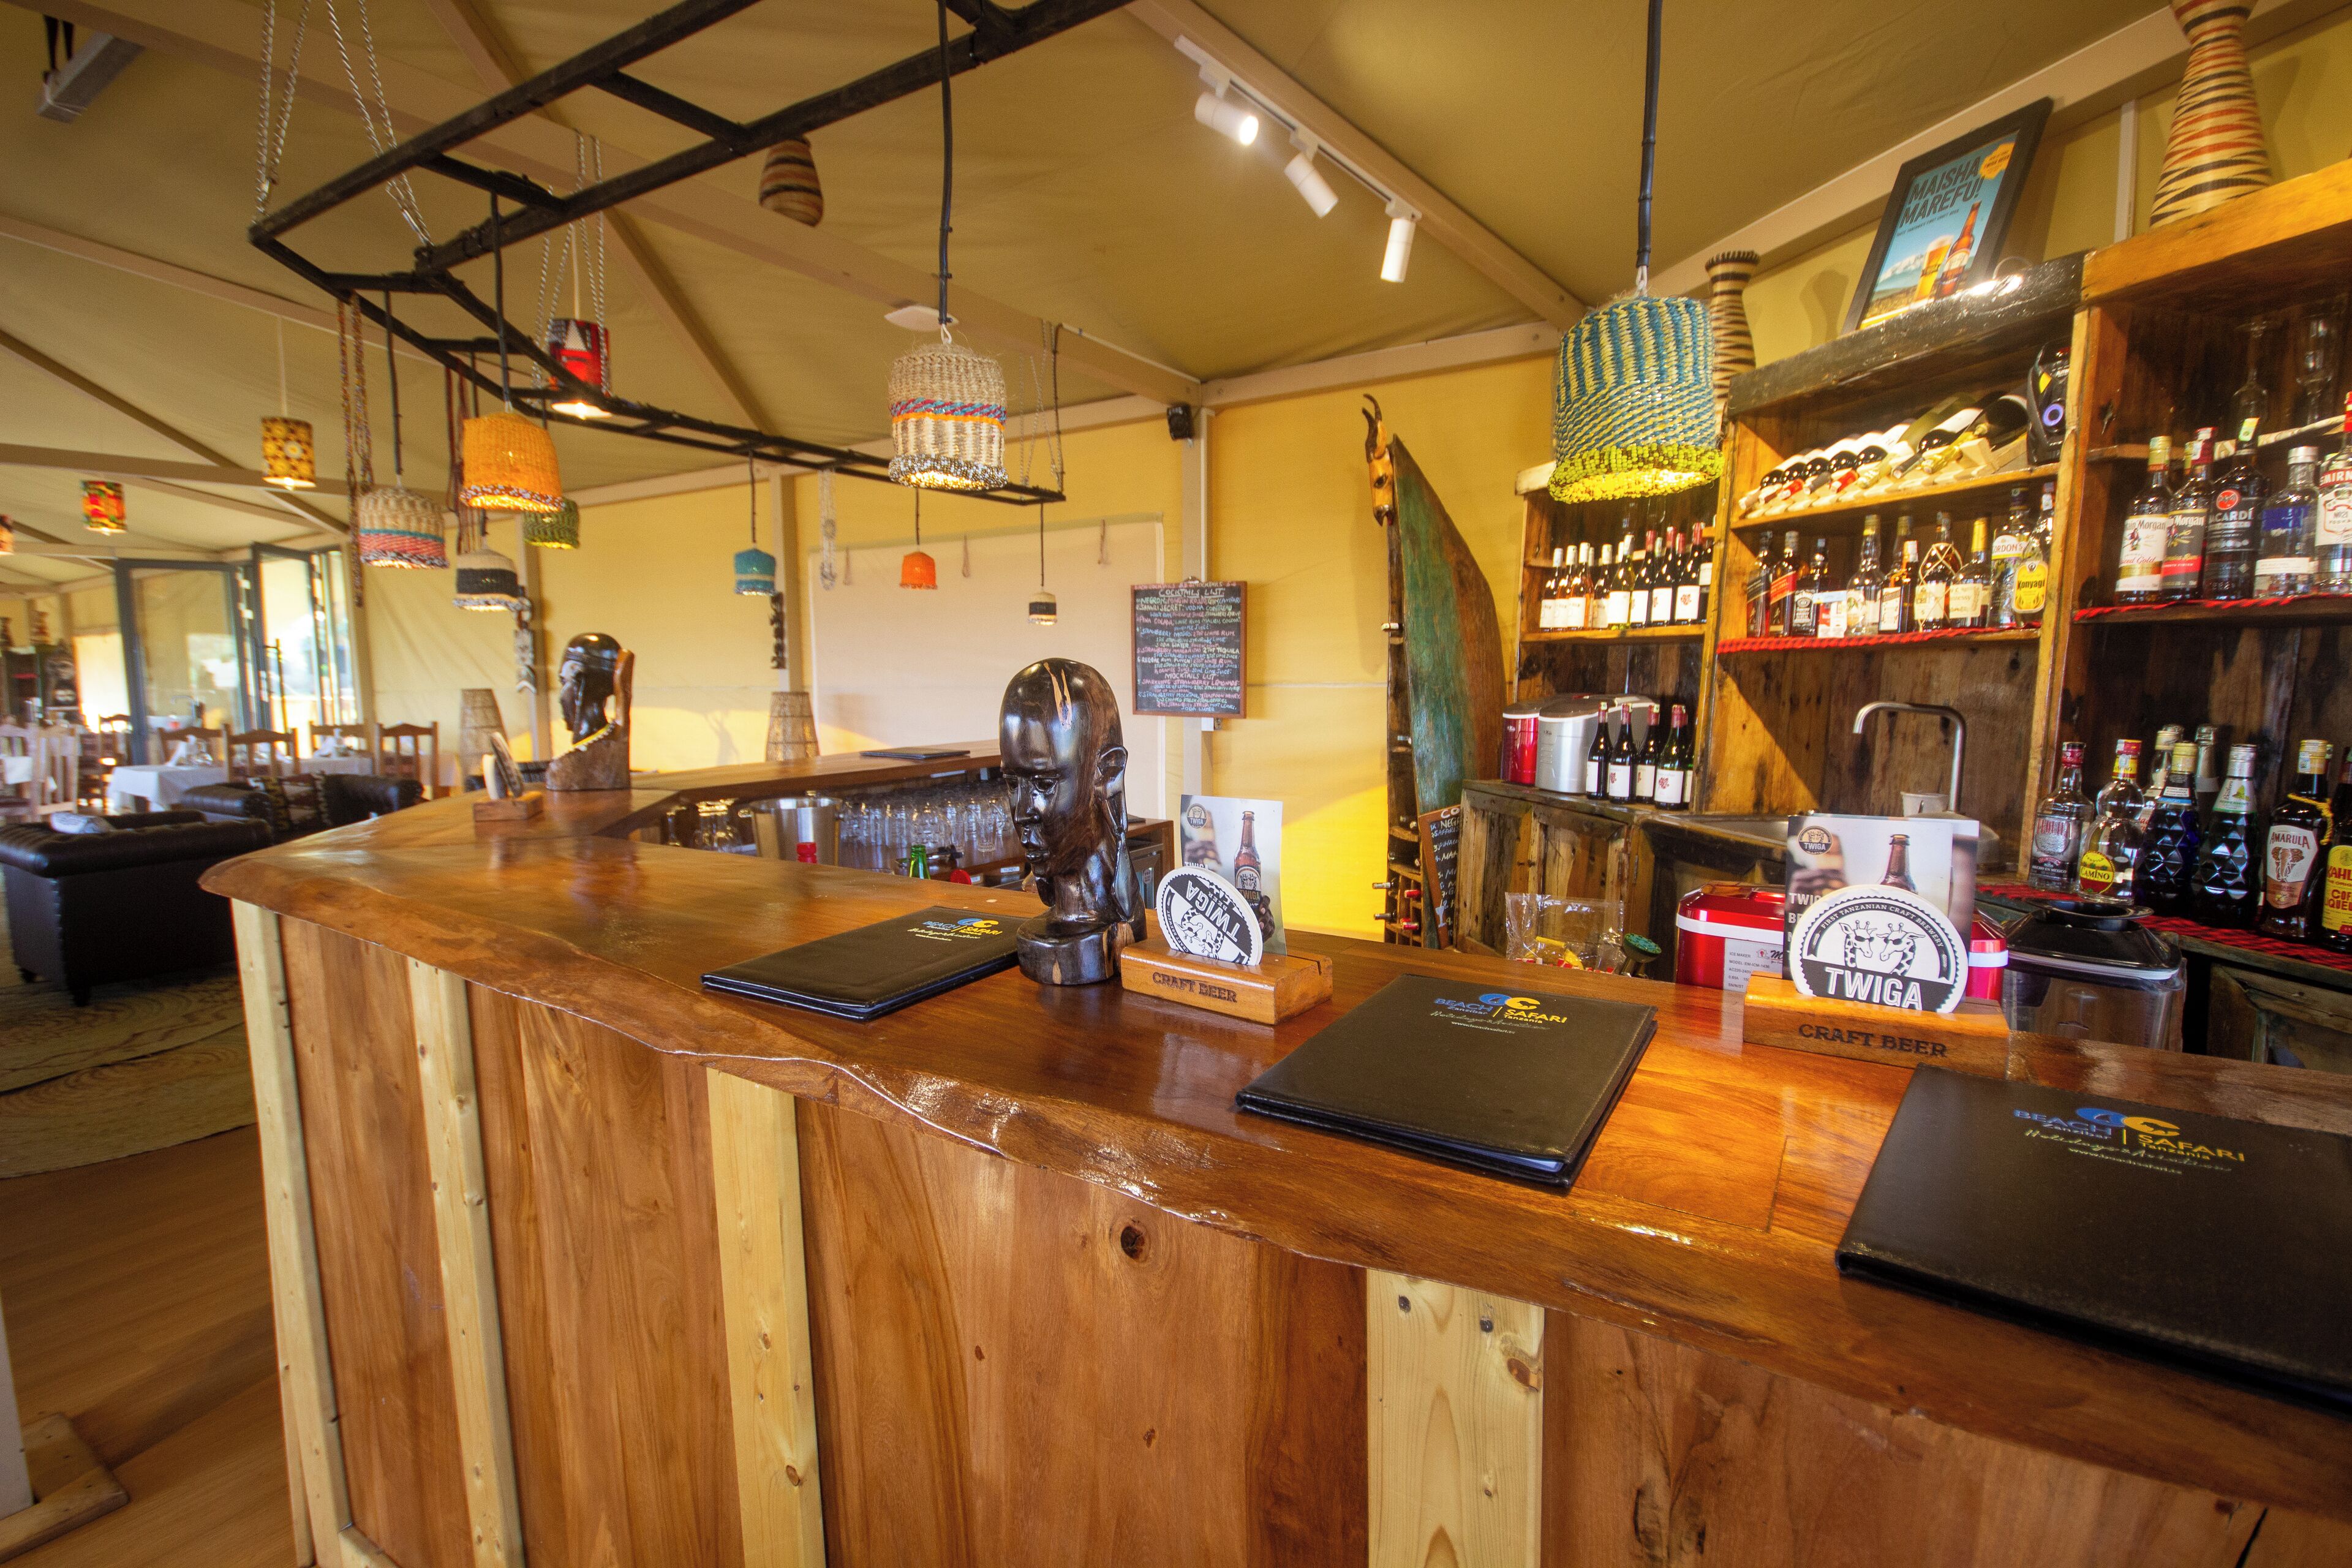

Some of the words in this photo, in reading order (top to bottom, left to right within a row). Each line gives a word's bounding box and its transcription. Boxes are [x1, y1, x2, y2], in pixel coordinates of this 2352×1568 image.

[1909, 156, 1981, 205] MAISHA
[1899, 175, 1985, 228] MAREFU!
[2138, 519, 2166, 531] Morgan
[2176, 515, 2206, 527] Morgan
[2136, 556, 2156, 564] Gold
[1159, 588, 1200, 597] COCKTAILS
[2018, 579, 2045, 590] Konyagi
[1804, 842, 1826, 851] TWIGA
[2270, 831, 2310, 850] AMARULA
[1208, 891, 1227, 911] BEER
[1789, 892, 1820, 905] TWIG
[1185, 880, 1240, 943] TWIGA
[964, 926, 1003, 936] SAFARI
[1821, 916, 1841, 929] FIRST
[1841, 904, 1888, 919] TANZANIAN
[1890, 907, 1916, 919] CRAFT
[1915, 916, 1944, 948] BREWERY
[1152, 971, 1196, 993] CRAFT
[1199, 982, 1237, 1003] BEER
[1825, 967, 1923, 1012] TWIGA
[1434, 998, 1493, 1012] BEACH
[1504, 1009, 1567, 1023] SAFARI
[1447, 1006, 1488, 1015] Zanzibar
[1504, 1014, 1543, 1023] Tanzania
[1798, 1023, 1875, 1047] CRAFT
[1880, 1034, 1948, 1058] BEER
[2014, 1109, 2111, 1135] BEACH
[2138, 1134, 2245, 1163] SAFARI
[2141, 1142, 2211, 1161] Tanzania
